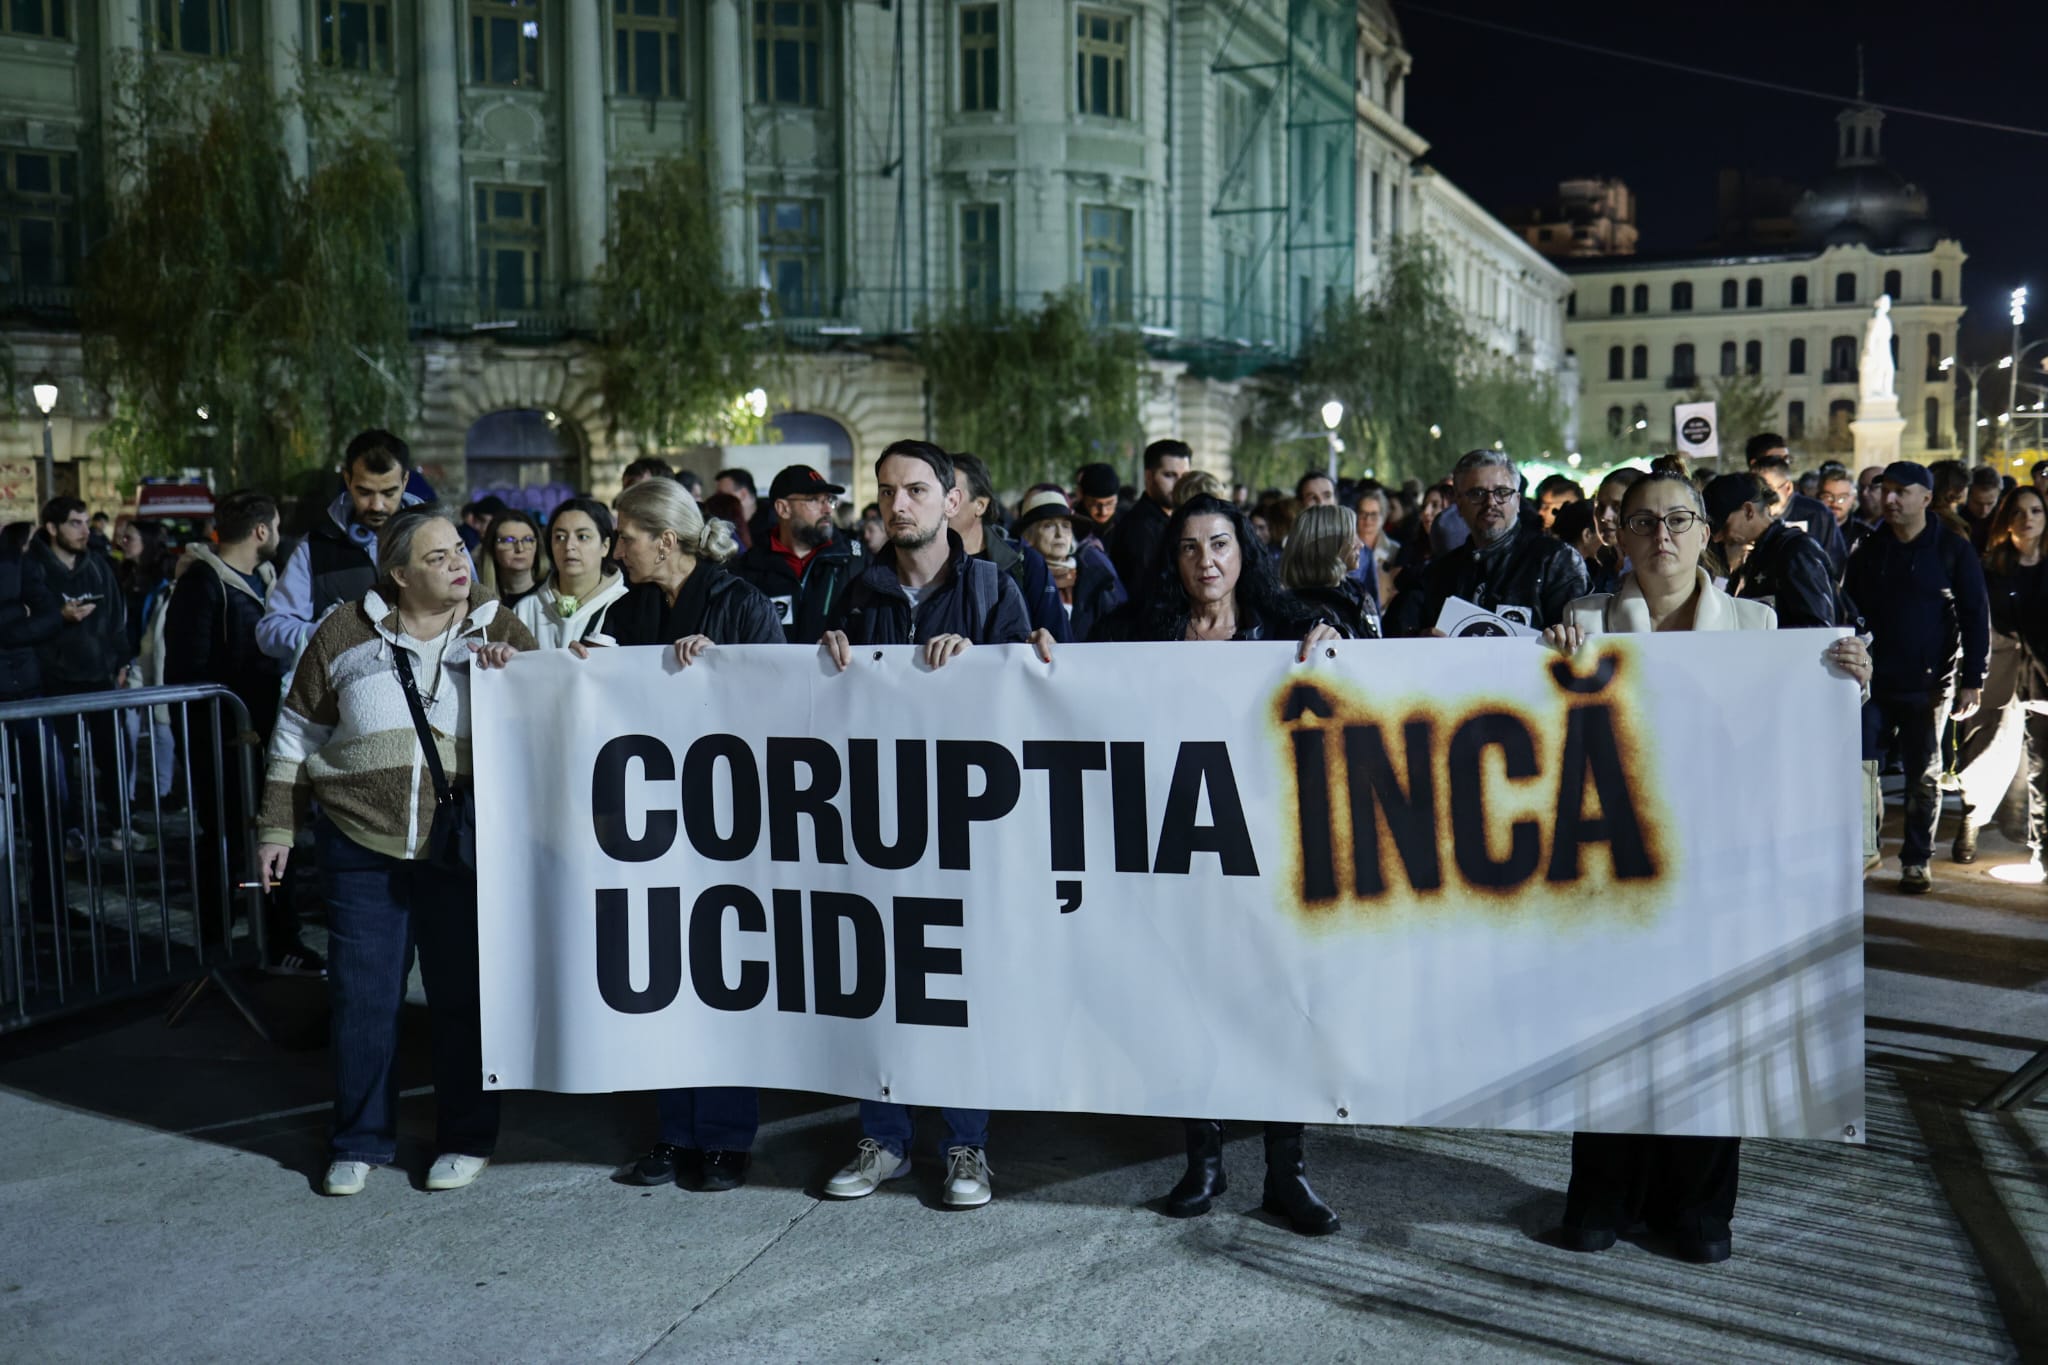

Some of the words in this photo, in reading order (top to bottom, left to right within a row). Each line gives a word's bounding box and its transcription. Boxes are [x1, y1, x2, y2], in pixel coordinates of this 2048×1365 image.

[592, 734, 1260, 914] CORUPȚIA
[1280, 653, 1659, 904] ÎNCĂ
[596, 885, 969, 1028] UCIDE
